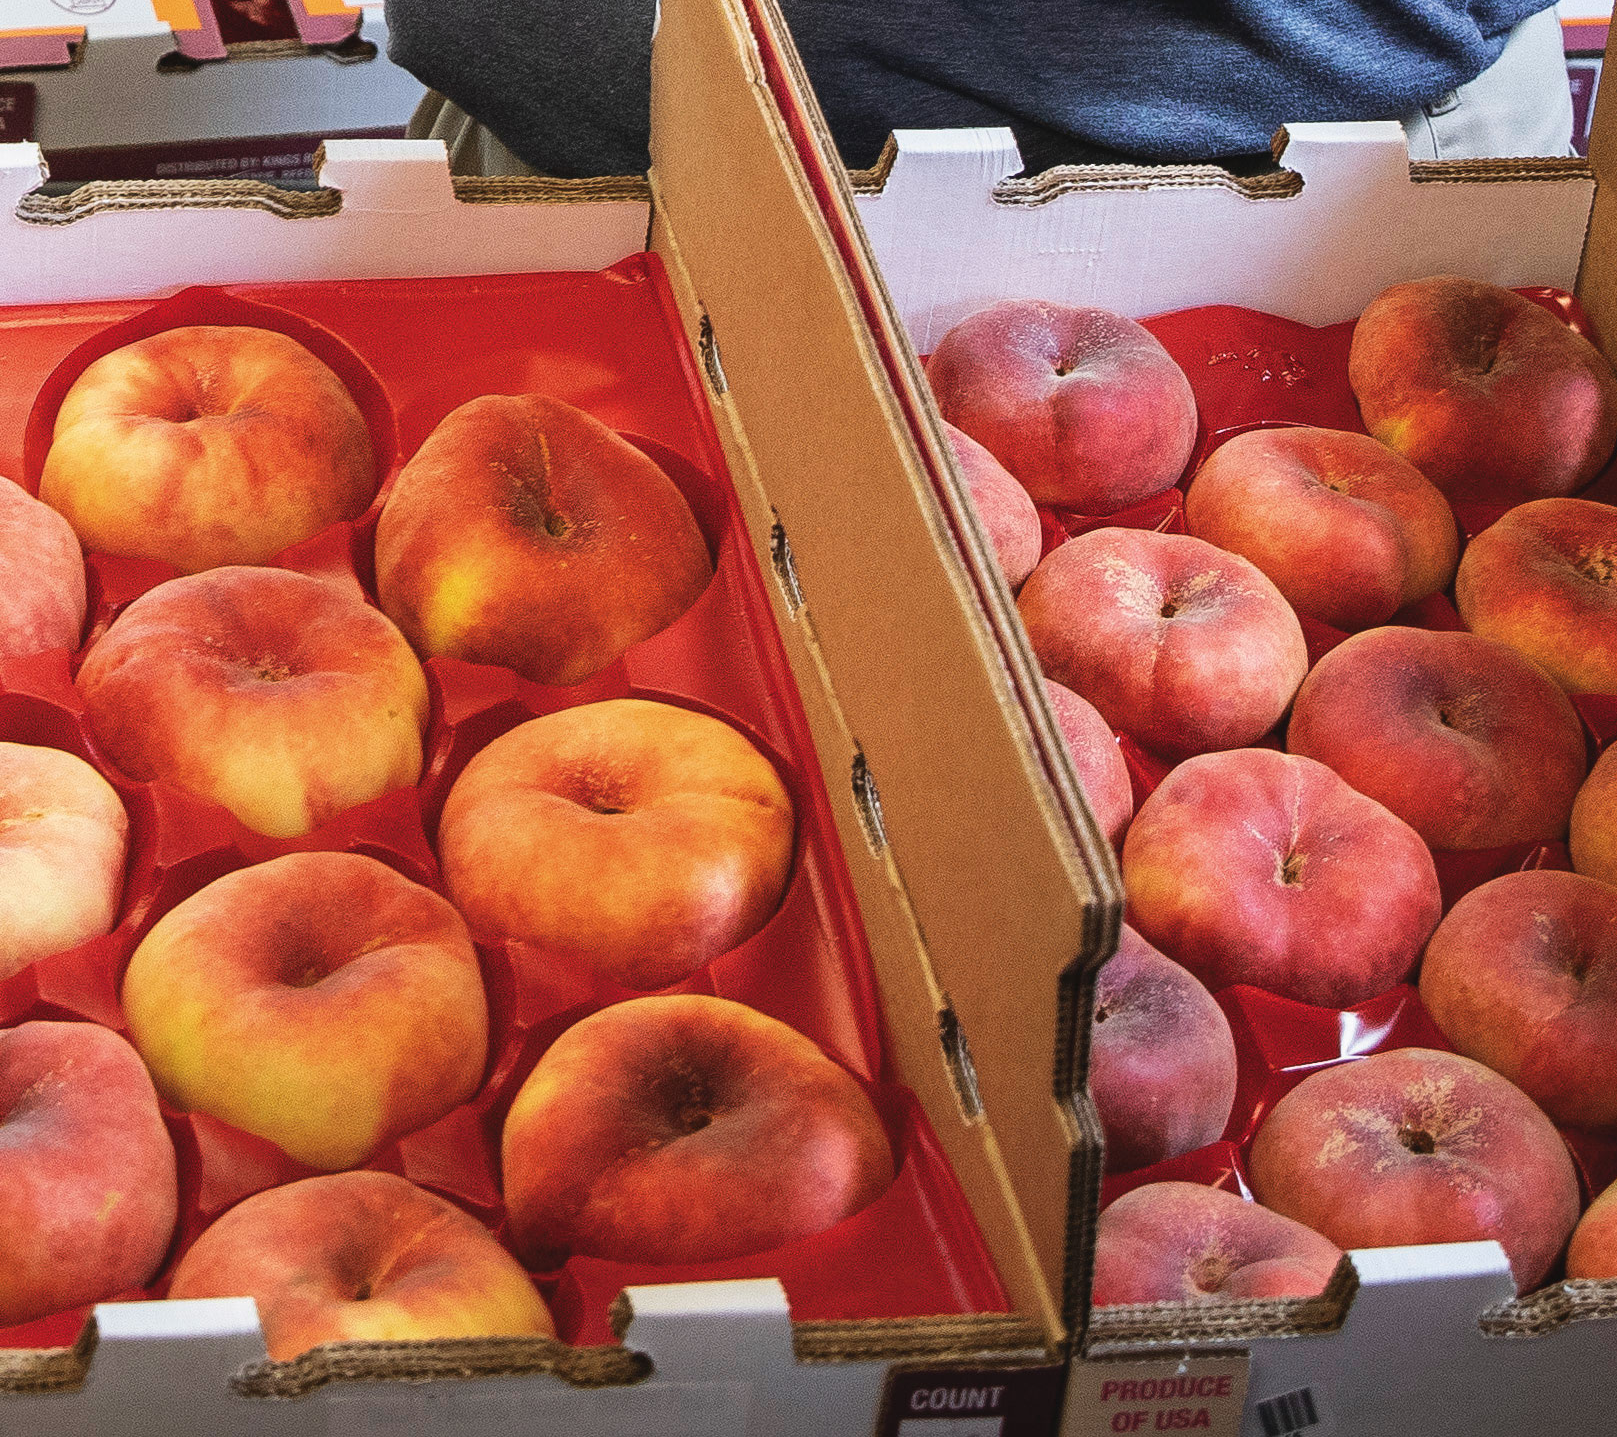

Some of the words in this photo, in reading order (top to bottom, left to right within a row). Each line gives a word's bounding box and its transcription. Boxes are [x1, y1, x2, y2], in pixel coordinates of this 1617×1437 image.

[910, 1385, 1005, 1410] COUNT
[1099, 1375, 1233, 1401] PRODUCE
[1111, 1409, 1150, 1433] OF
[1155, 1407, 1212, 1430] USA
